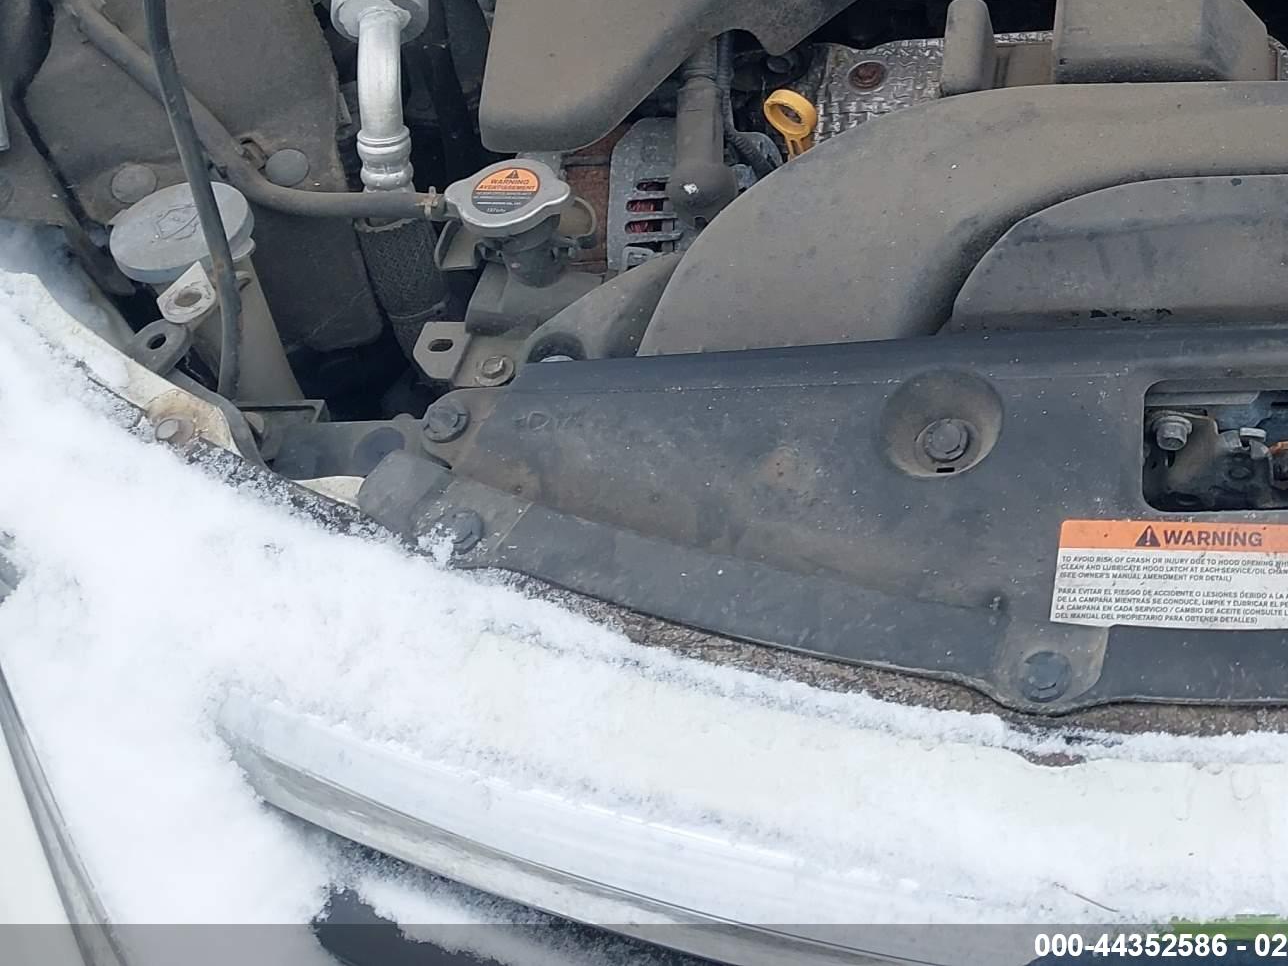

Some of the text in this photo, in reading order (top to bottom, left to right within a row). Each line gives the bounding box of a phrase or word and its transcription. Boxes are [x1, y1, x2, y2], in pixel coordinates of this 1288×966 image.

[1163, 529, 1263, 546] WARNING
[1152, 557, 1163, 565] OR
[1190, 558, 1206, 566] DUE
[1111, 572, 1141, 580] MANUAL
[1205, 574, 1232, 582] DETAIL)
[1185, 615, 1219, 623] OBTENER
[1219, 616, 1258, 624] DETALLES)
